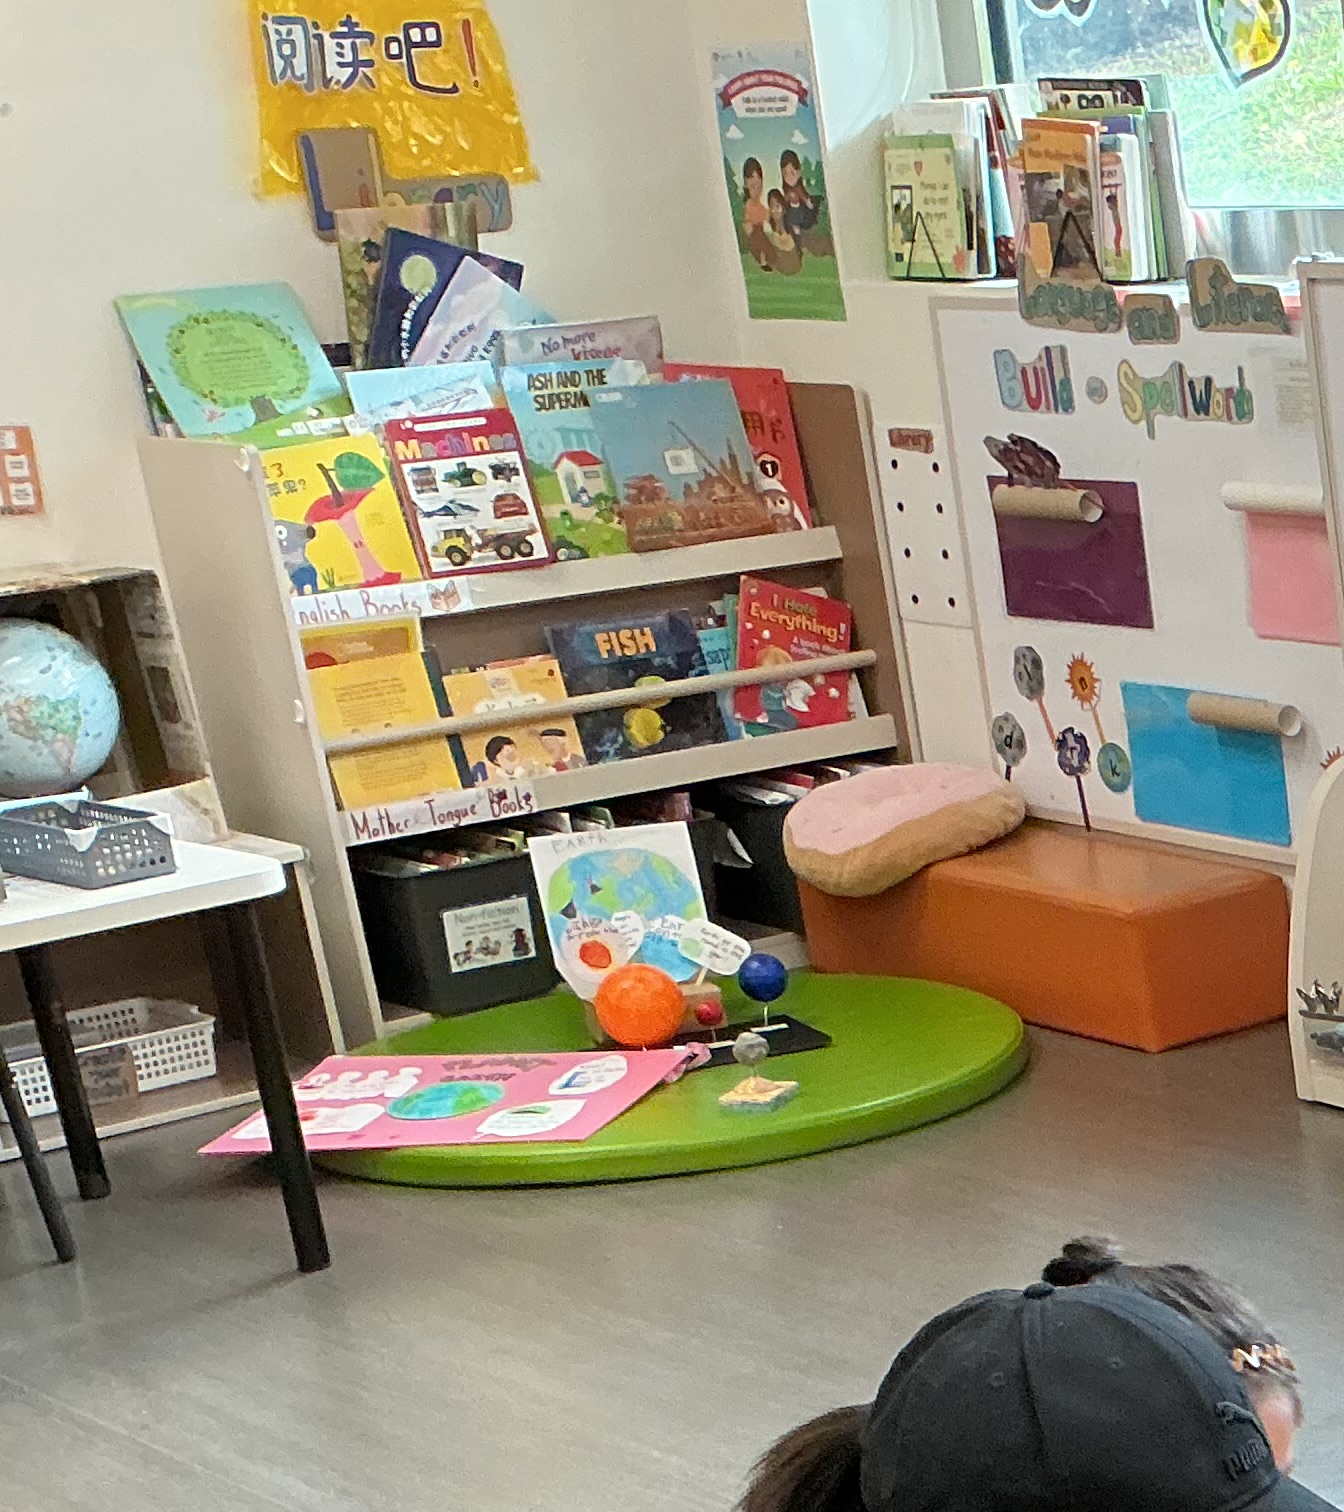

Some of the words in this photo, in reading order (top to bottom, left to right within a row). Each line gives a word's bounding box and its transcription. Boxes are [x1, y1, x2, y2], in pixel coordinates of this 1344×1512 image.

[527, 371, 554, 392] ASH
[556, 370, 582, 389] AND
[584, 367, 608, 387] THE
[993, 344, 1075, 415] Build
[1186, 365, 1253, 423] Word
[394, 431, 517, 461] Machines
[359, 590, 423, 619] Books
[749, 600, 847, 643] Everything!
[595, 626, 658, 659] FISH
[1108, 757, 1121, 780] k
[351, 807, 412, 841] Mother
[424, 798, 479, 828] Tongue
[487, 787, 536, 816] Books
